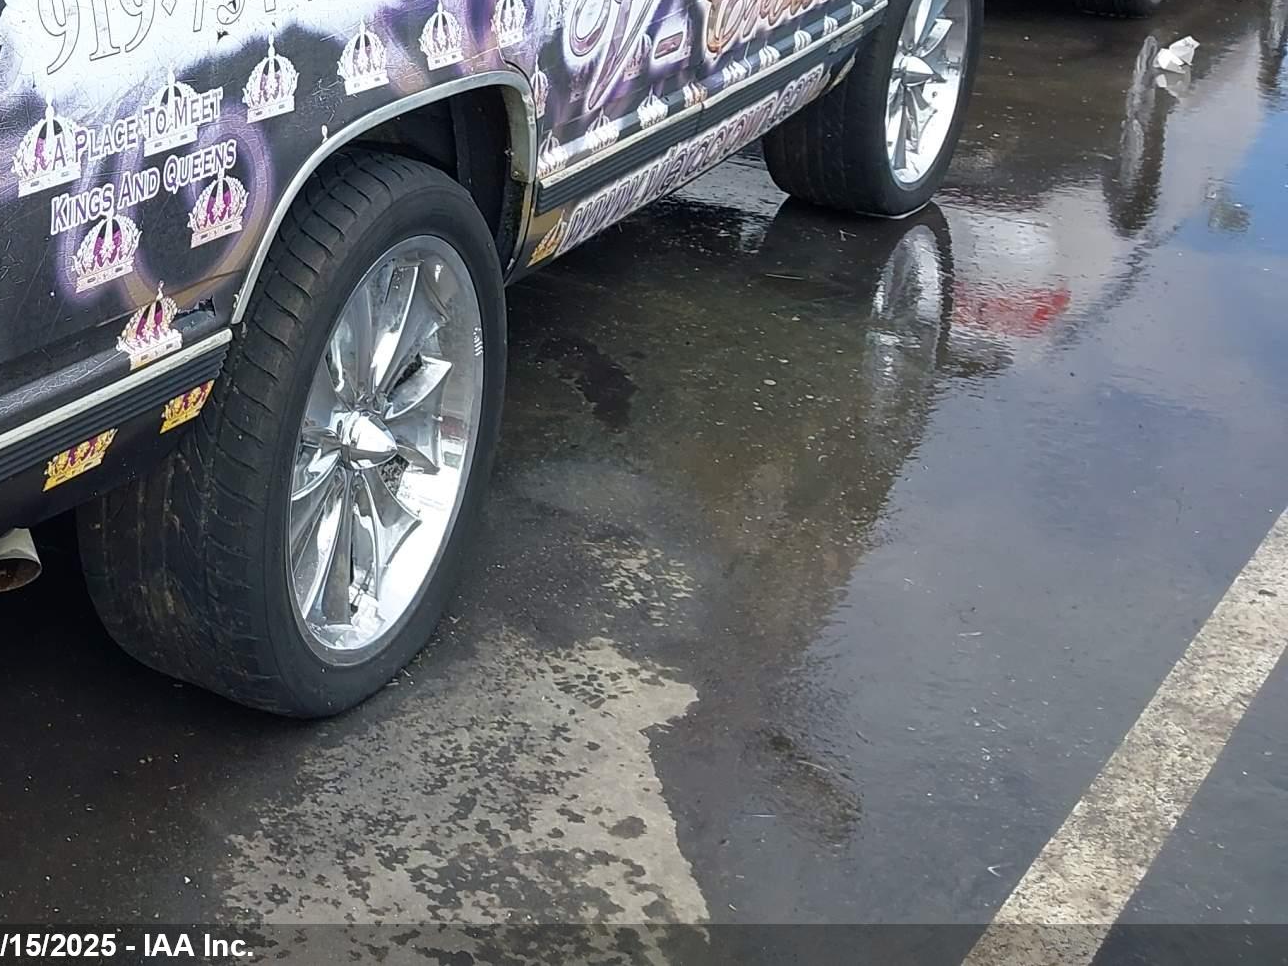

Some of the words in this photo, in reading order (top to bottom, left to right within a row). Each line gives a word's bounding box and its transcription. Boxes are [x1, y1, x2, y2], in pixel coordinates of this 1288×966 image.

[52, 136, 68, 171] A
[74, 115, 138, 163] PLACE
[143, 106, 168, 138] TO
[173, 87, 223, 130] MEET
[51, 184, 115, 234] KINGS
[117, 167, 161, 209] AND
[164, 139, 237, 194] QUEENS
